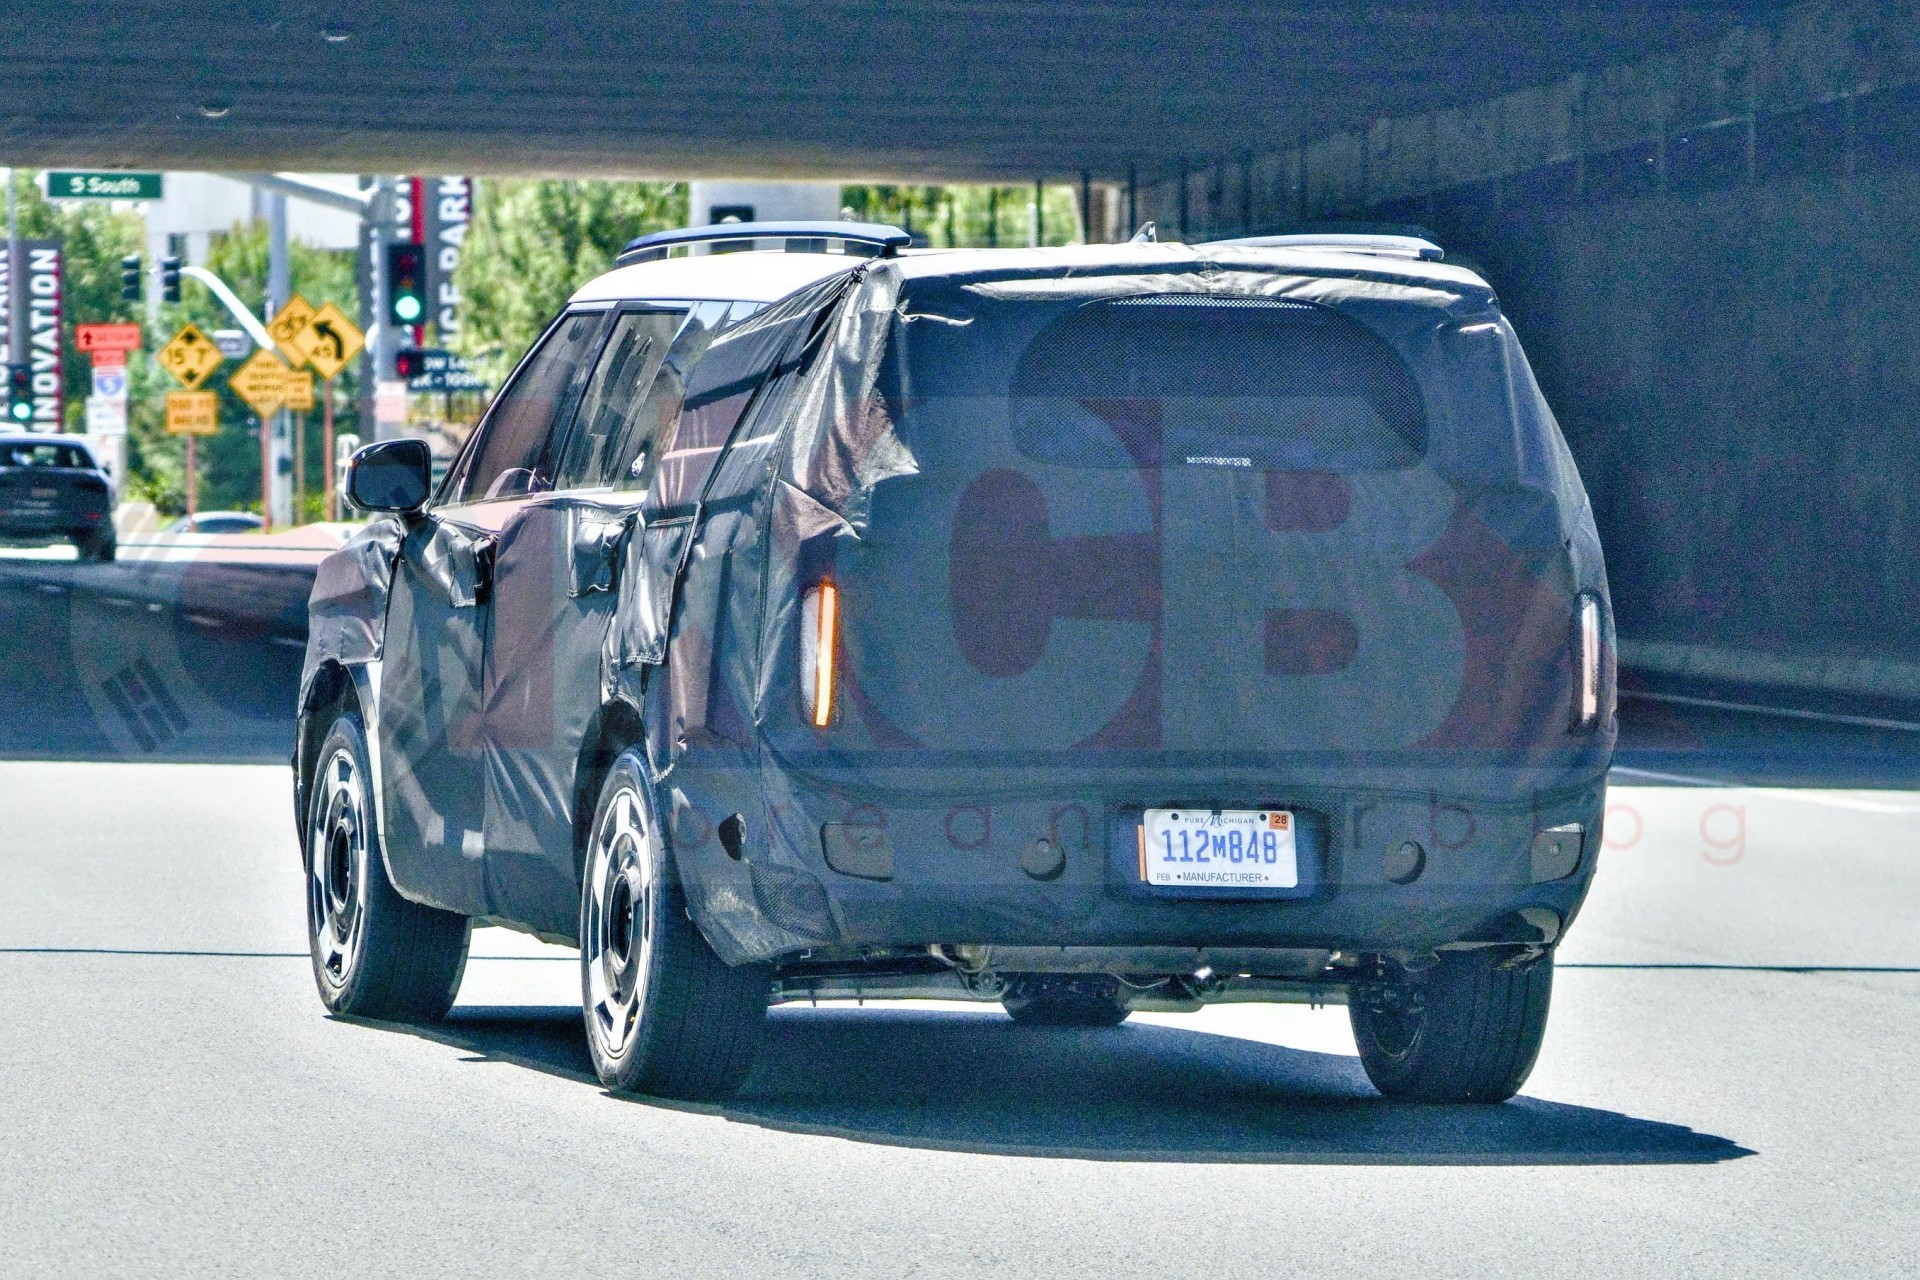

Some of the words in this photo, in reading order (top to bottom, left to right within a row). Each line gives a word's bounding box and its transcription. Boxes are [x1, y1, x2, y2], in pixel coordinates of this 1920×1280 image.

[87, 176, 140, 194] South
[1161, 829, 1277, 864] 112M848
[1156, 872, 1171, 882] FEB
[1182, 872, 1263, 883] MANUFACTURER
